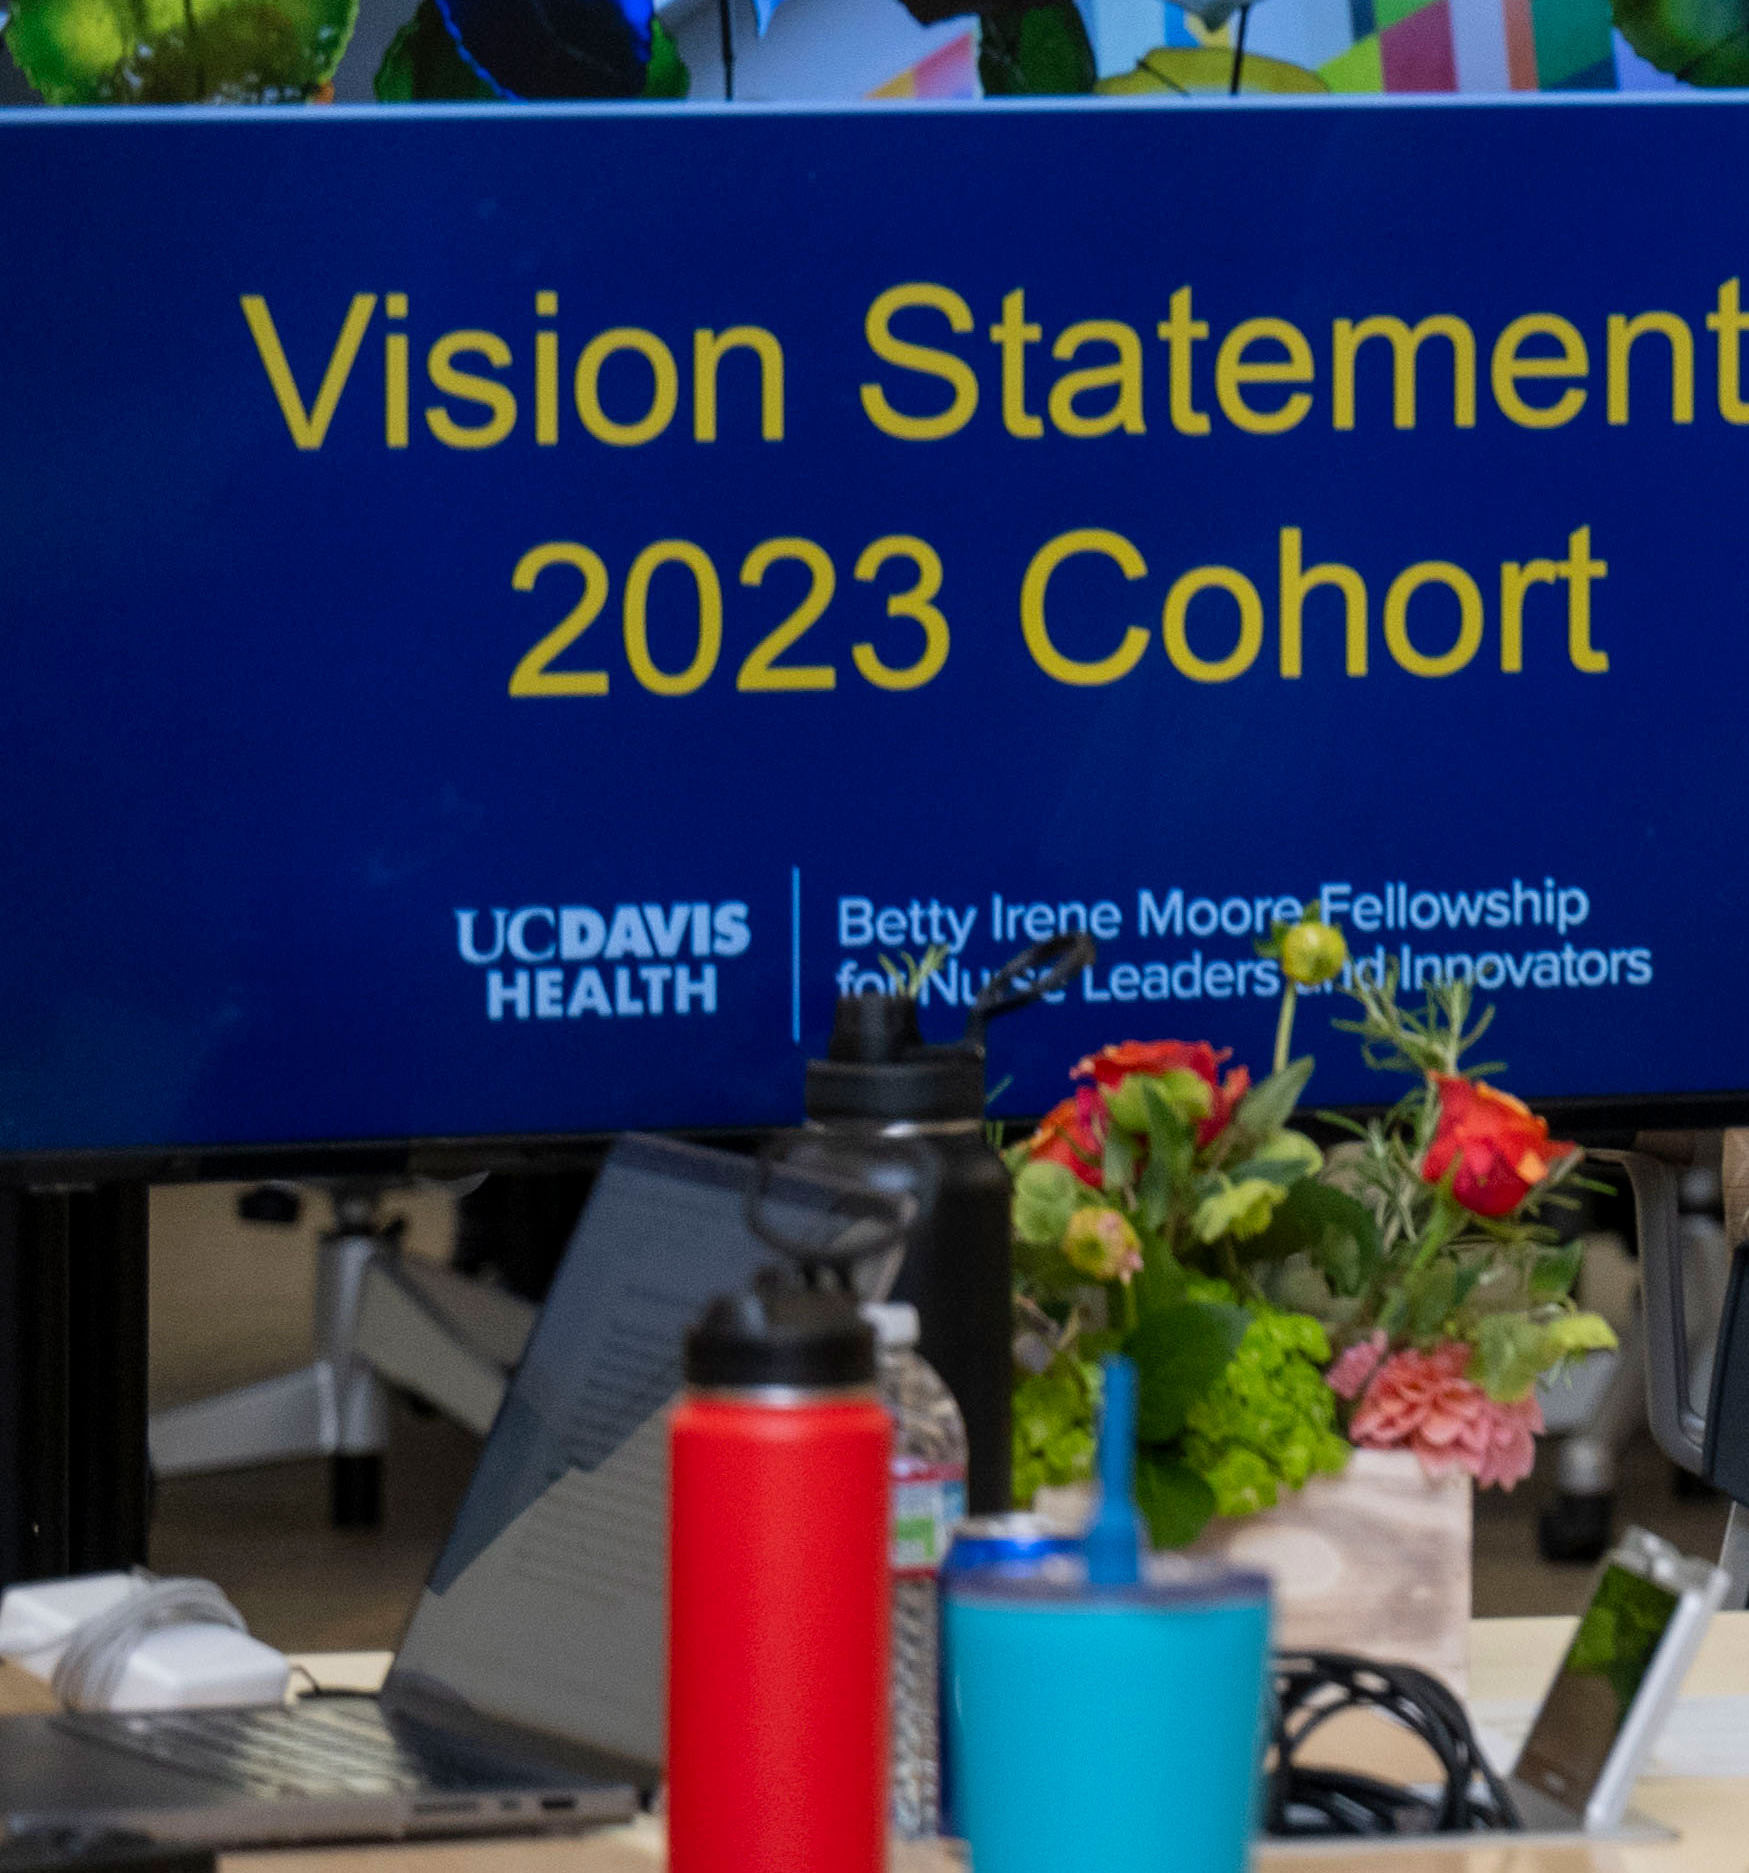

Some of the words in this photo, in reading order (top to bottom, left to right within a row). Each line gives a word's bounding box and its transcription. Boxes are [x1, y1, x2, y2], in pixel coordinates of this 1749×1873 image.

[243, 293, 783, 448] Vision
[509, 536, 948, 696] 2023
[1020, 528, 1608, 685] Cohort
[838, 895, 978, 954] Betty
[992, 891, 1122, 942] Irene
[1137, 887, 1304, 937] Moore
[1320, 877, 1591, 935] Fellowship
[487, 964, 717, 1020] HEALTH
[1083, 948, 1280, 1003] Leaders
[1401, 941, 1653, 992] Innovators
